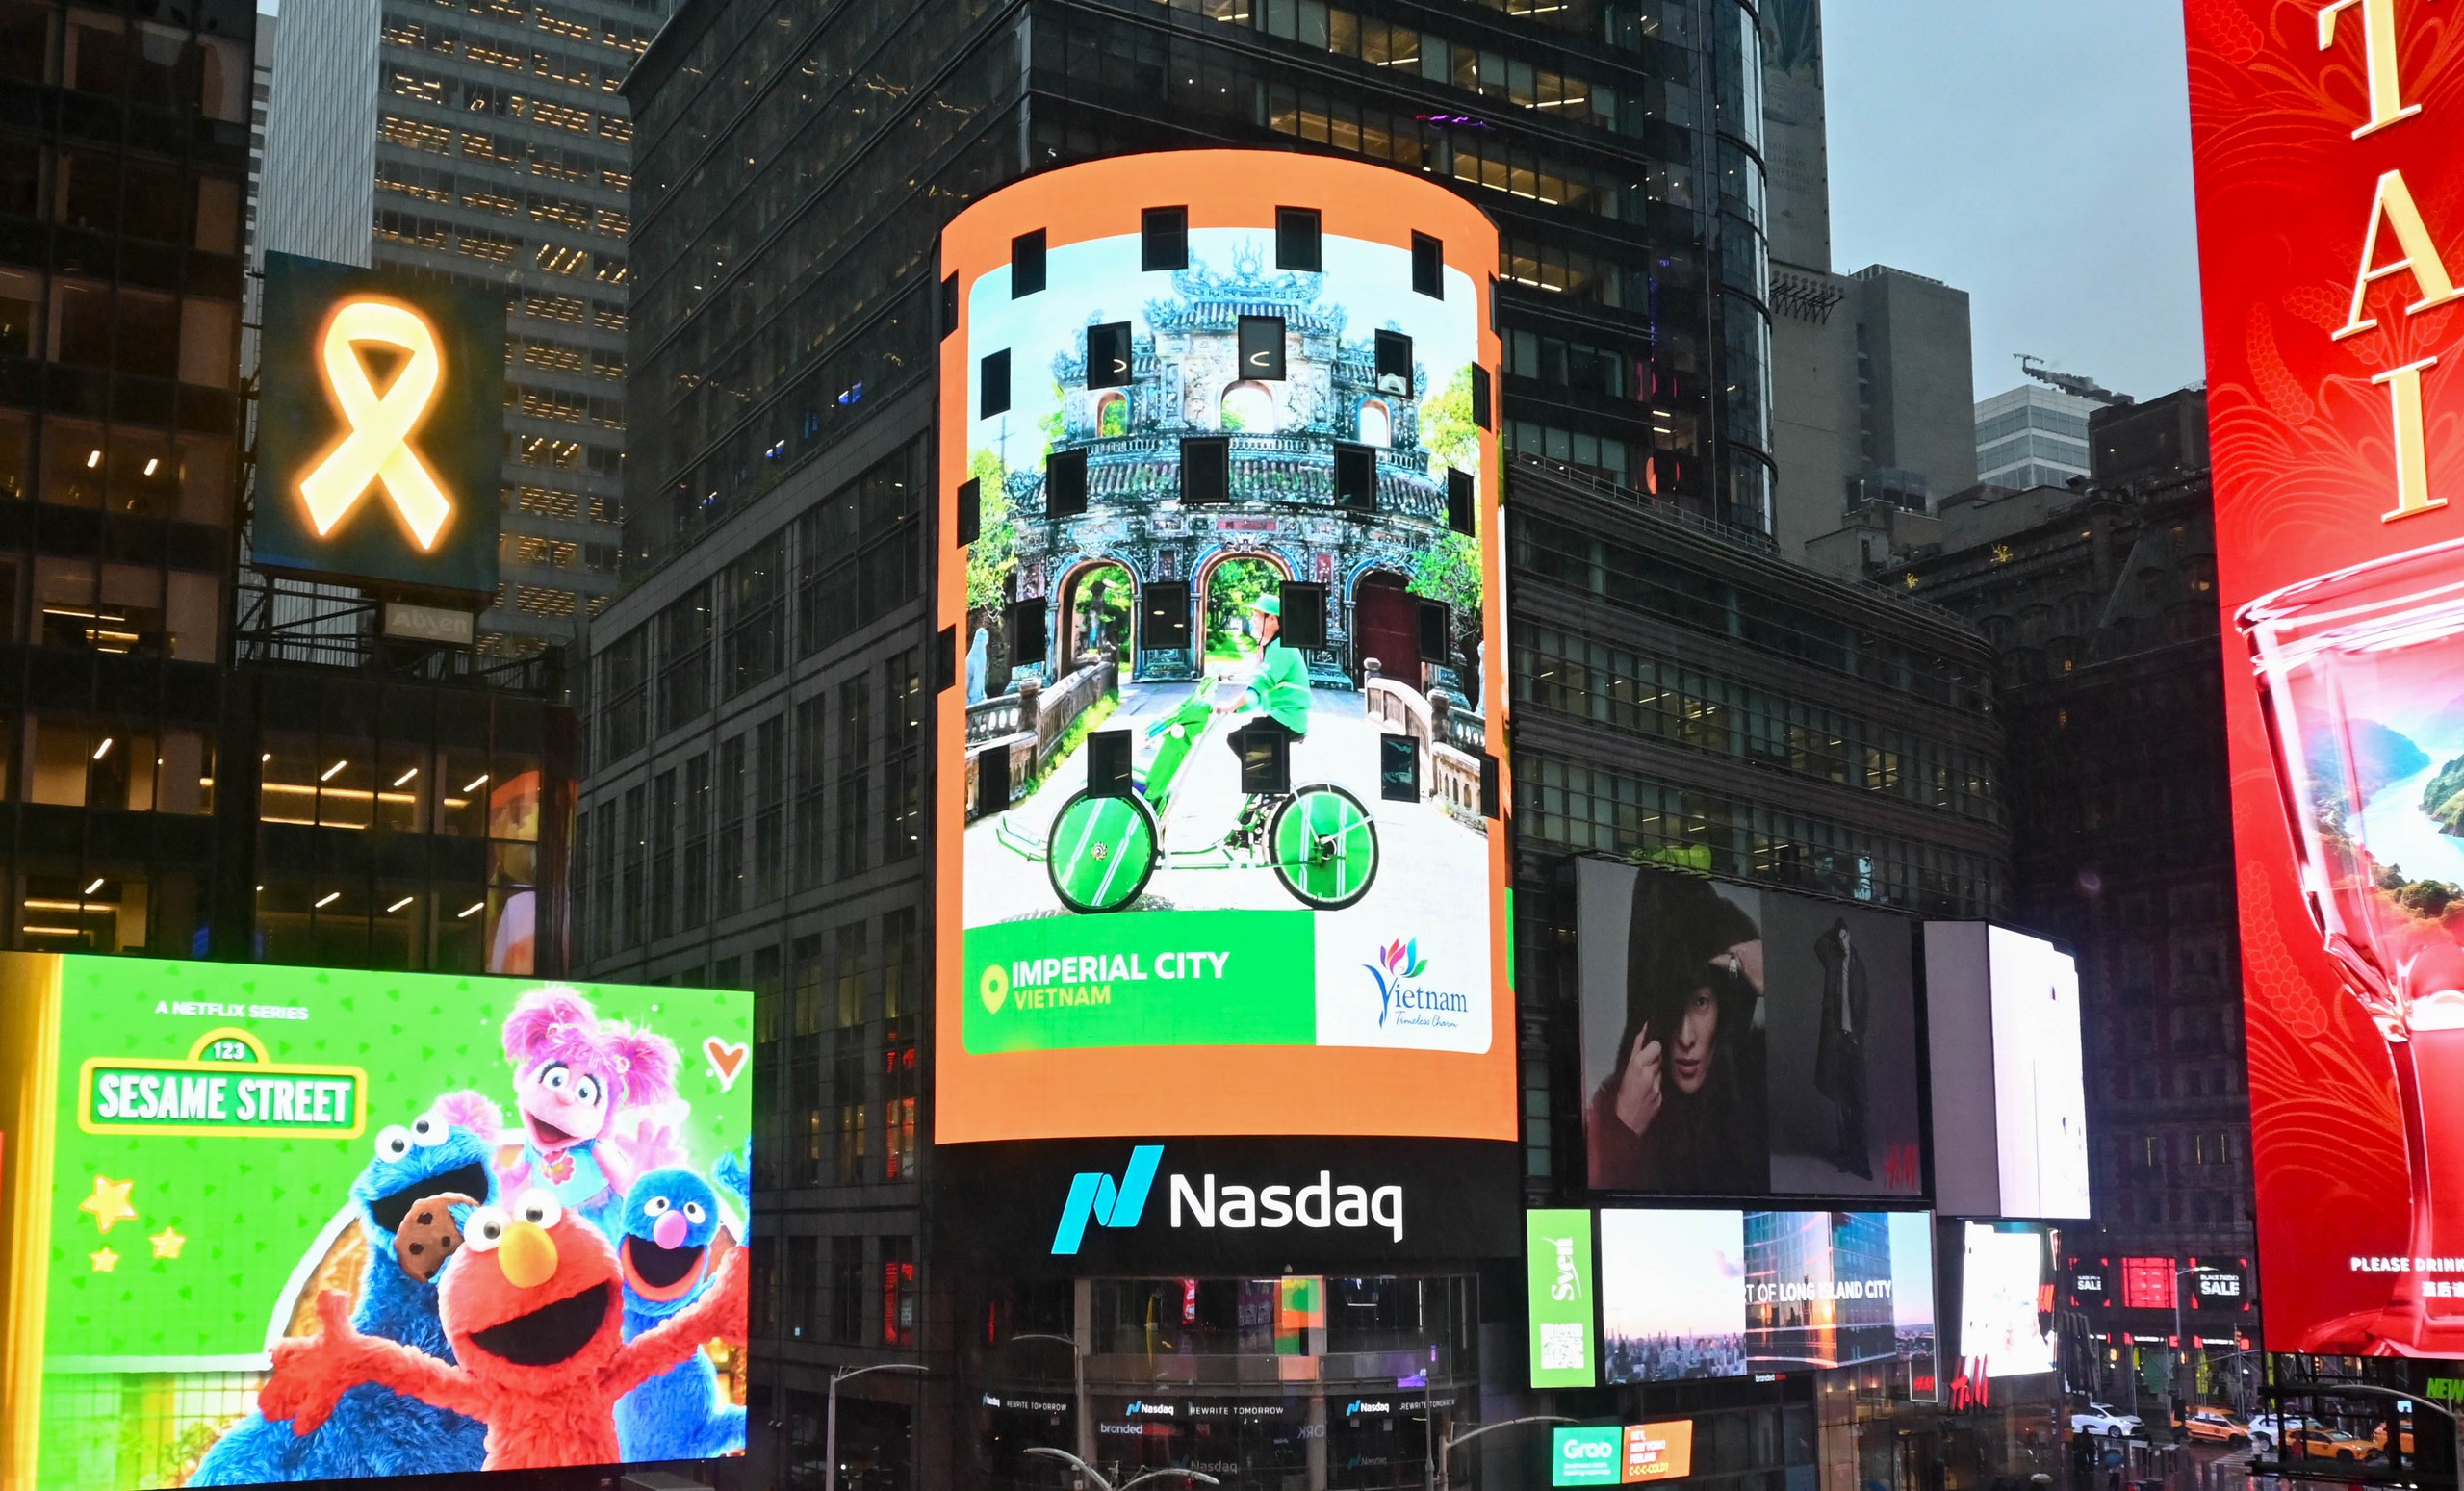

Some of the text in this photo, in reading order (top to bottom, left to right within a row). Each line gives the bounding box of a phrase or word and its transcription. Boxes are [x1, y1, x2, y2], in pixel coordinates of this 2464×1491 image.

[1012, 951, 1231, 988] IMPERIAL CITY
[1014, 985, 1111, 1010] VIETNAM
[1361, 964, 1469, 1029] Vietnam
[155, 1000, 309, 1020] A NETFLIX SERIES
[1395, 1010, 1459, 1027] Timeless Charm
[214, 1041, 246, 1061] 123
[97, 1073, 351, 1123] SESAME STREET
[1170, 1170, 1403, 1244] Nasdaq
[1541, 1236, 1582, 1301] Sven
[2350, 1257, 2411, 1272] PLEASE
[1758, 1282, 1777, 1301] OF
[1780, 1281, 1816, 1301] LONG
[1864, 1279, 1892, 1298] CITY
[2077, 1280, 2102, 1291] SALE
[2200, 1281, 2240, 1296] SALE
[1006, 1400, 1029, 1409] REWRITE
[1031, 1401, 1067, 1412] TOMORROW
[1141, 1403, 1284, 1416] Nasdaq REWRITE TOMORROW
[1360, 1401, 1390, 1414] Nasdaq
[1100, 1423, 1143, 1434] branded
[1563, 1439, 1613, 1459] Grab
[1190, 1460, 1238, 1475] Nasdaq
